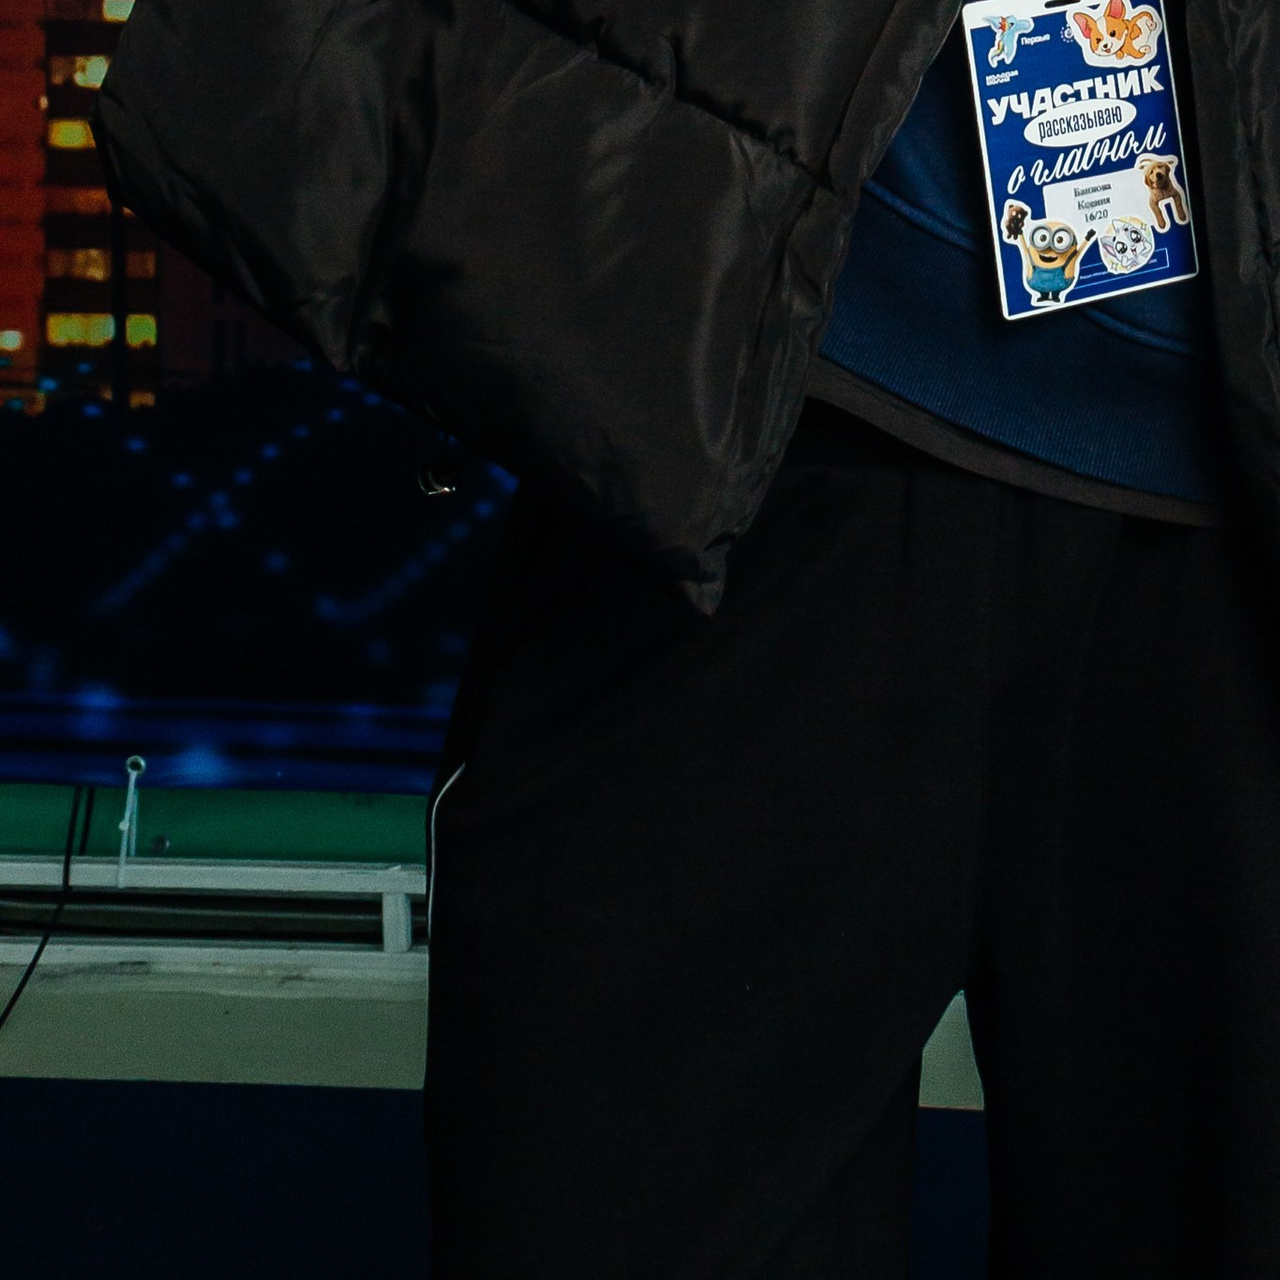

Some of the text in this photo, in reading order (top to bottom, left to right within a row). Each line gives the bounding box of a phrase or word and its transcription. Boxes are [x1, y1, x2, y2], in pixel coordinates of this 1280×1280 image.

[986, 64, 1165, 125] УЧАСТНИК
[1038, 104, 1124, 142] рассказываю
[1007, 121, 1167, 195] о главном
[1084, 208, 1109, 223] 16/20
